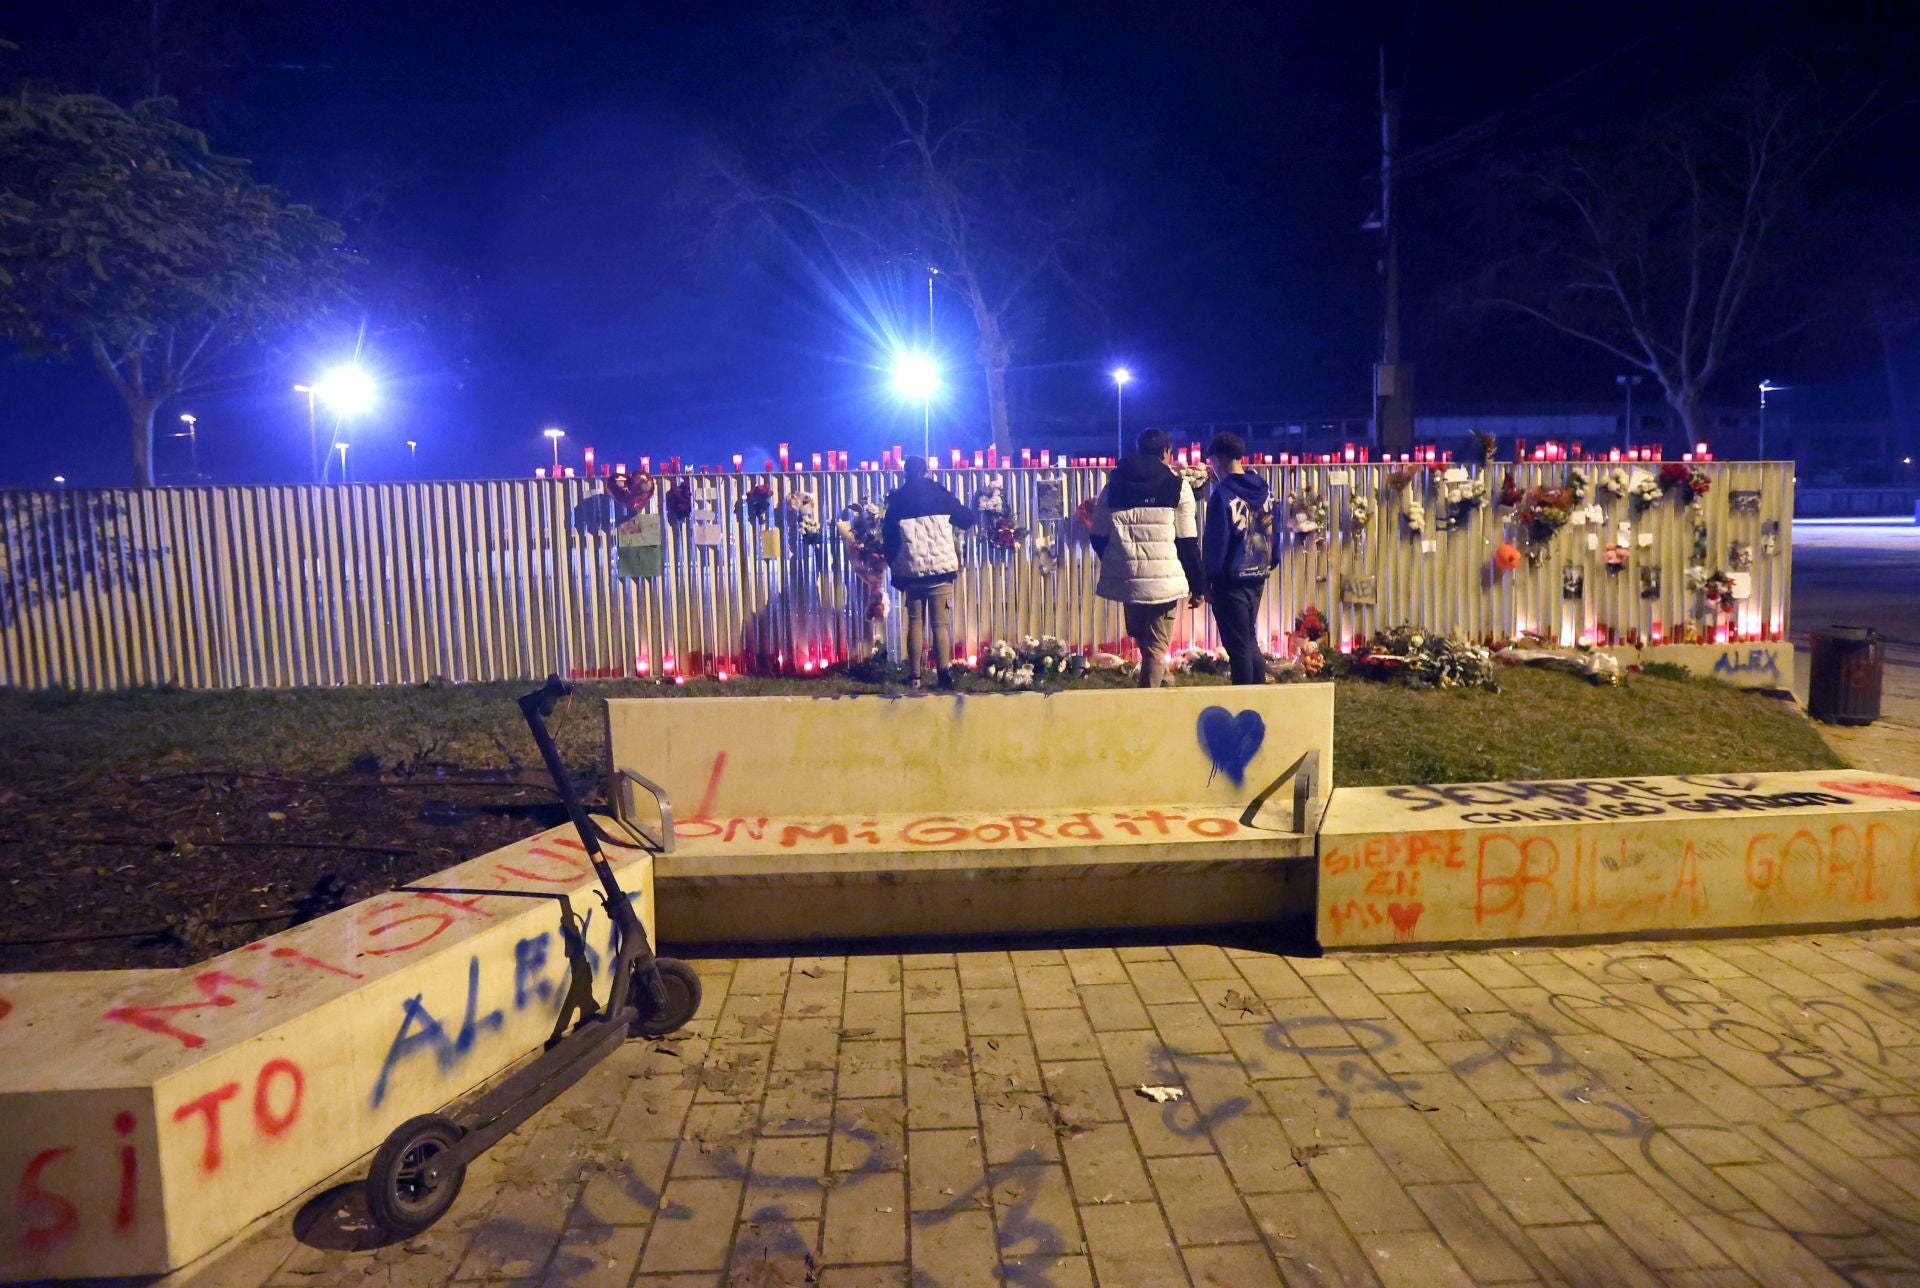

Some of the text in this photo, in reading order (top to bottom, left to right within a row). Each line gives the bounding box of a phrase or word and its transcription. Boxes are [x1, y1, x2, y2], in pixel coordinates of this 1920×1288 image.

[1713, 648, 1782, 679] ALEX
[1460, 801, 1666, 824] CONMIGO
[1745, 822, 1920, 907] GORD
